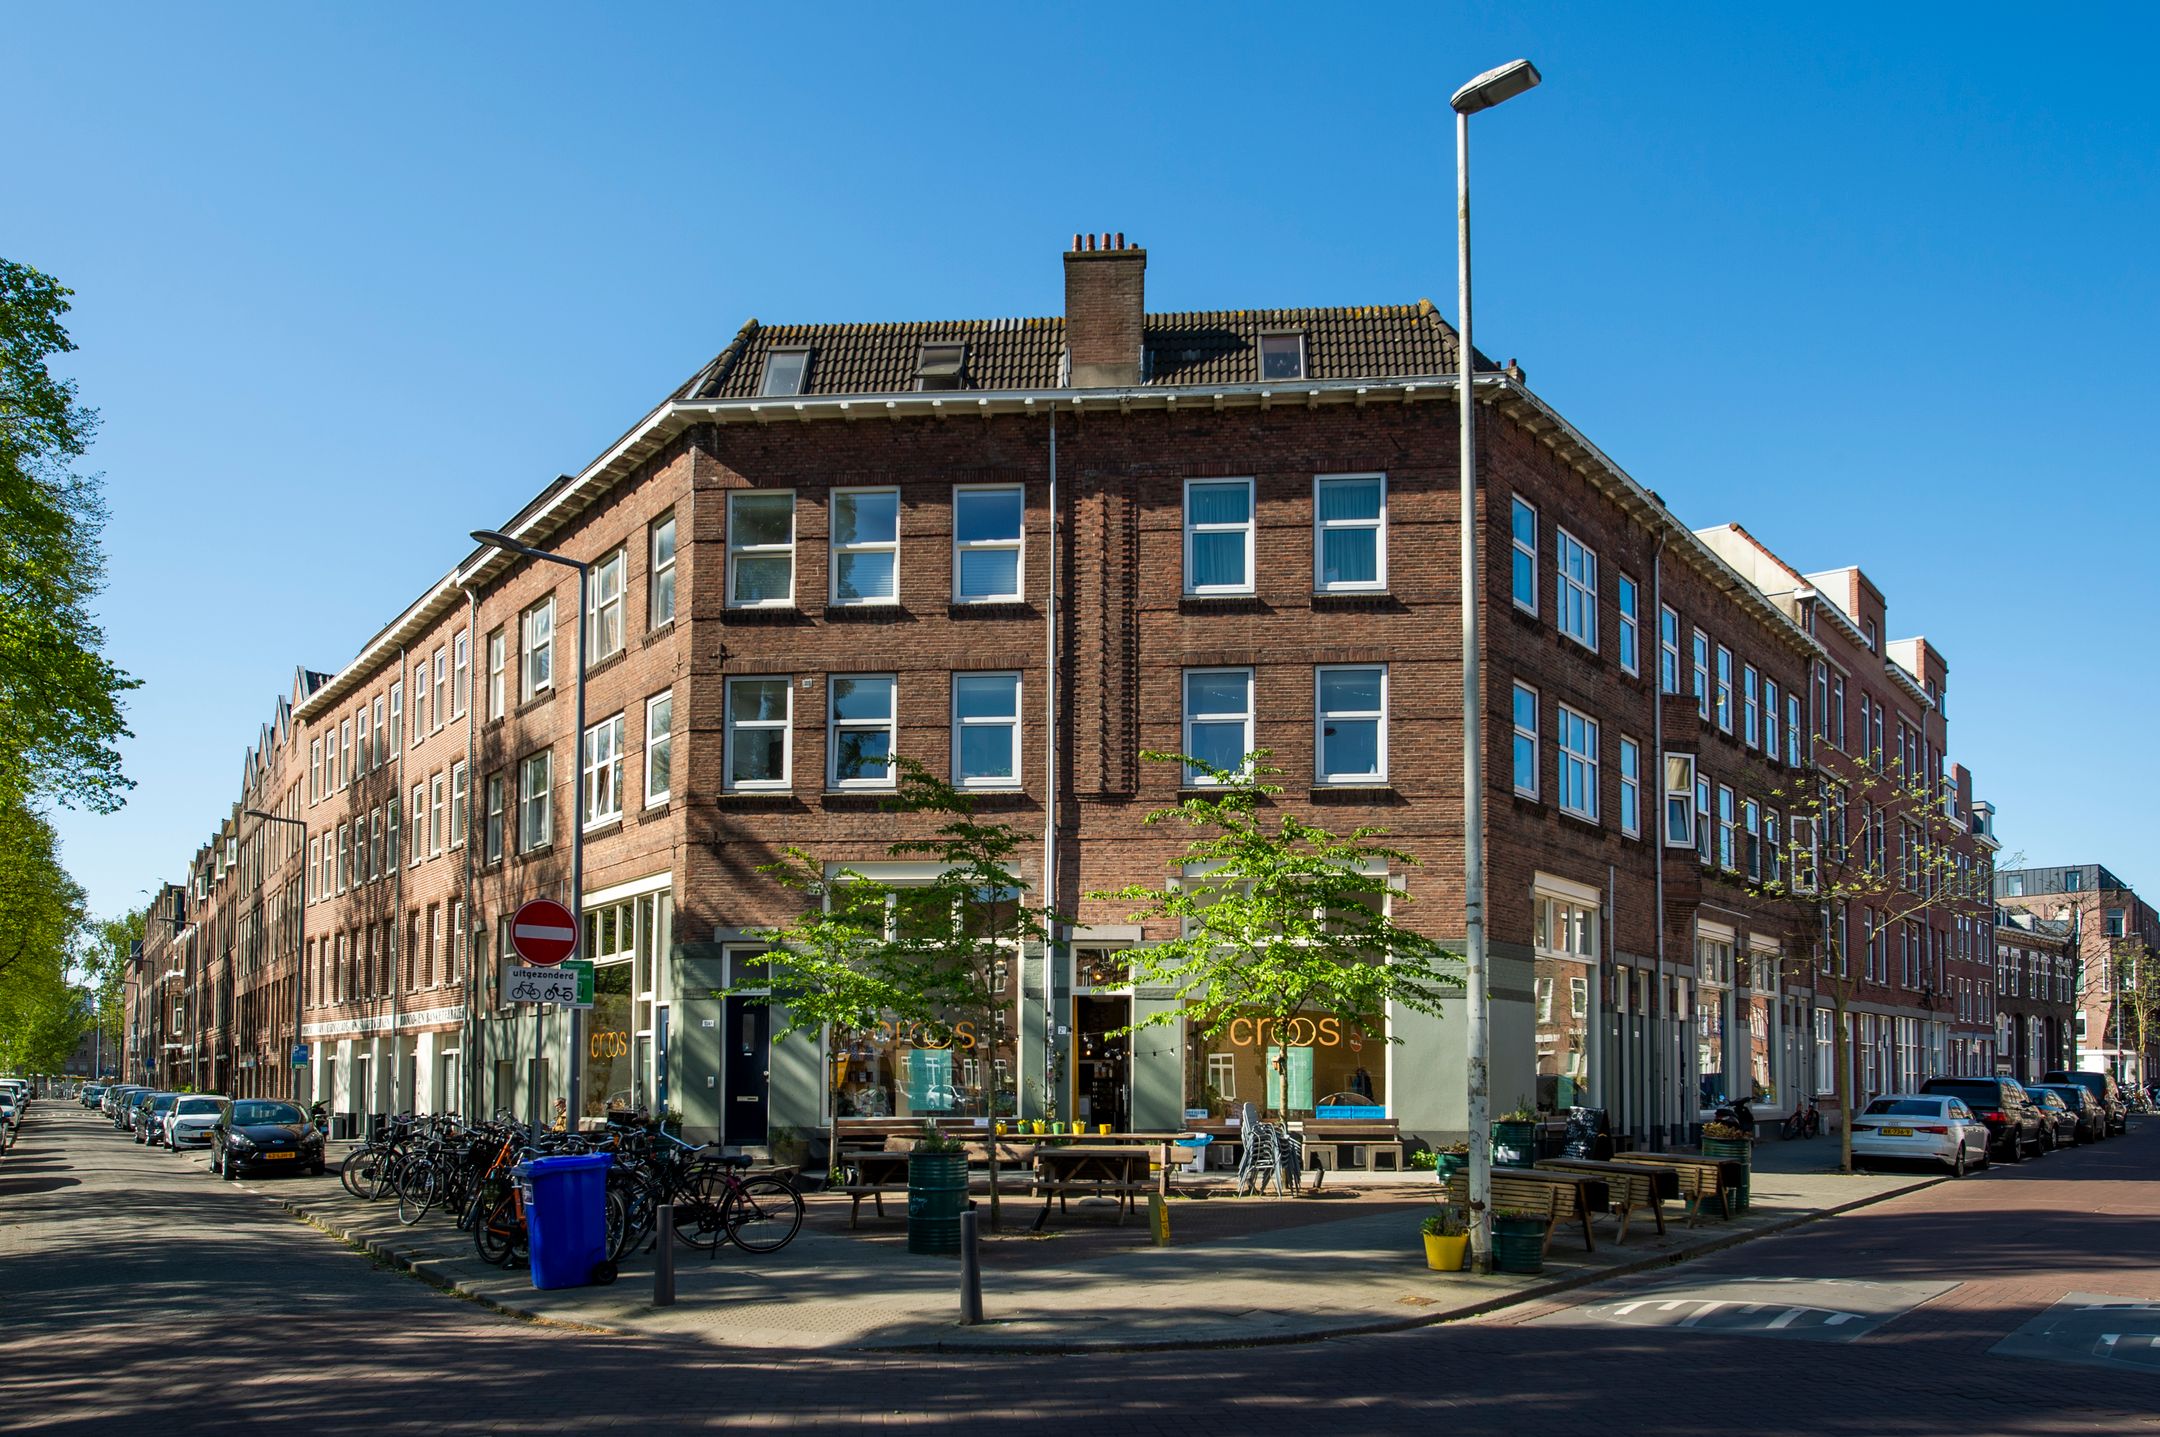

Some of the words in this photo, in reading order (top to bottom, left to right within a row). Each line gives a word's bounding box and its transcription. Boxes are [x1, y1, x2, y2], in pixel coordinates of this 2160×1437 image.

[513, 970, 574, 979] uitgezonderd
[1230, 1017, 1340, 1047] croos
[293, 1045, 300, 1053] P
[591, 1031, 627, 1057] croos
